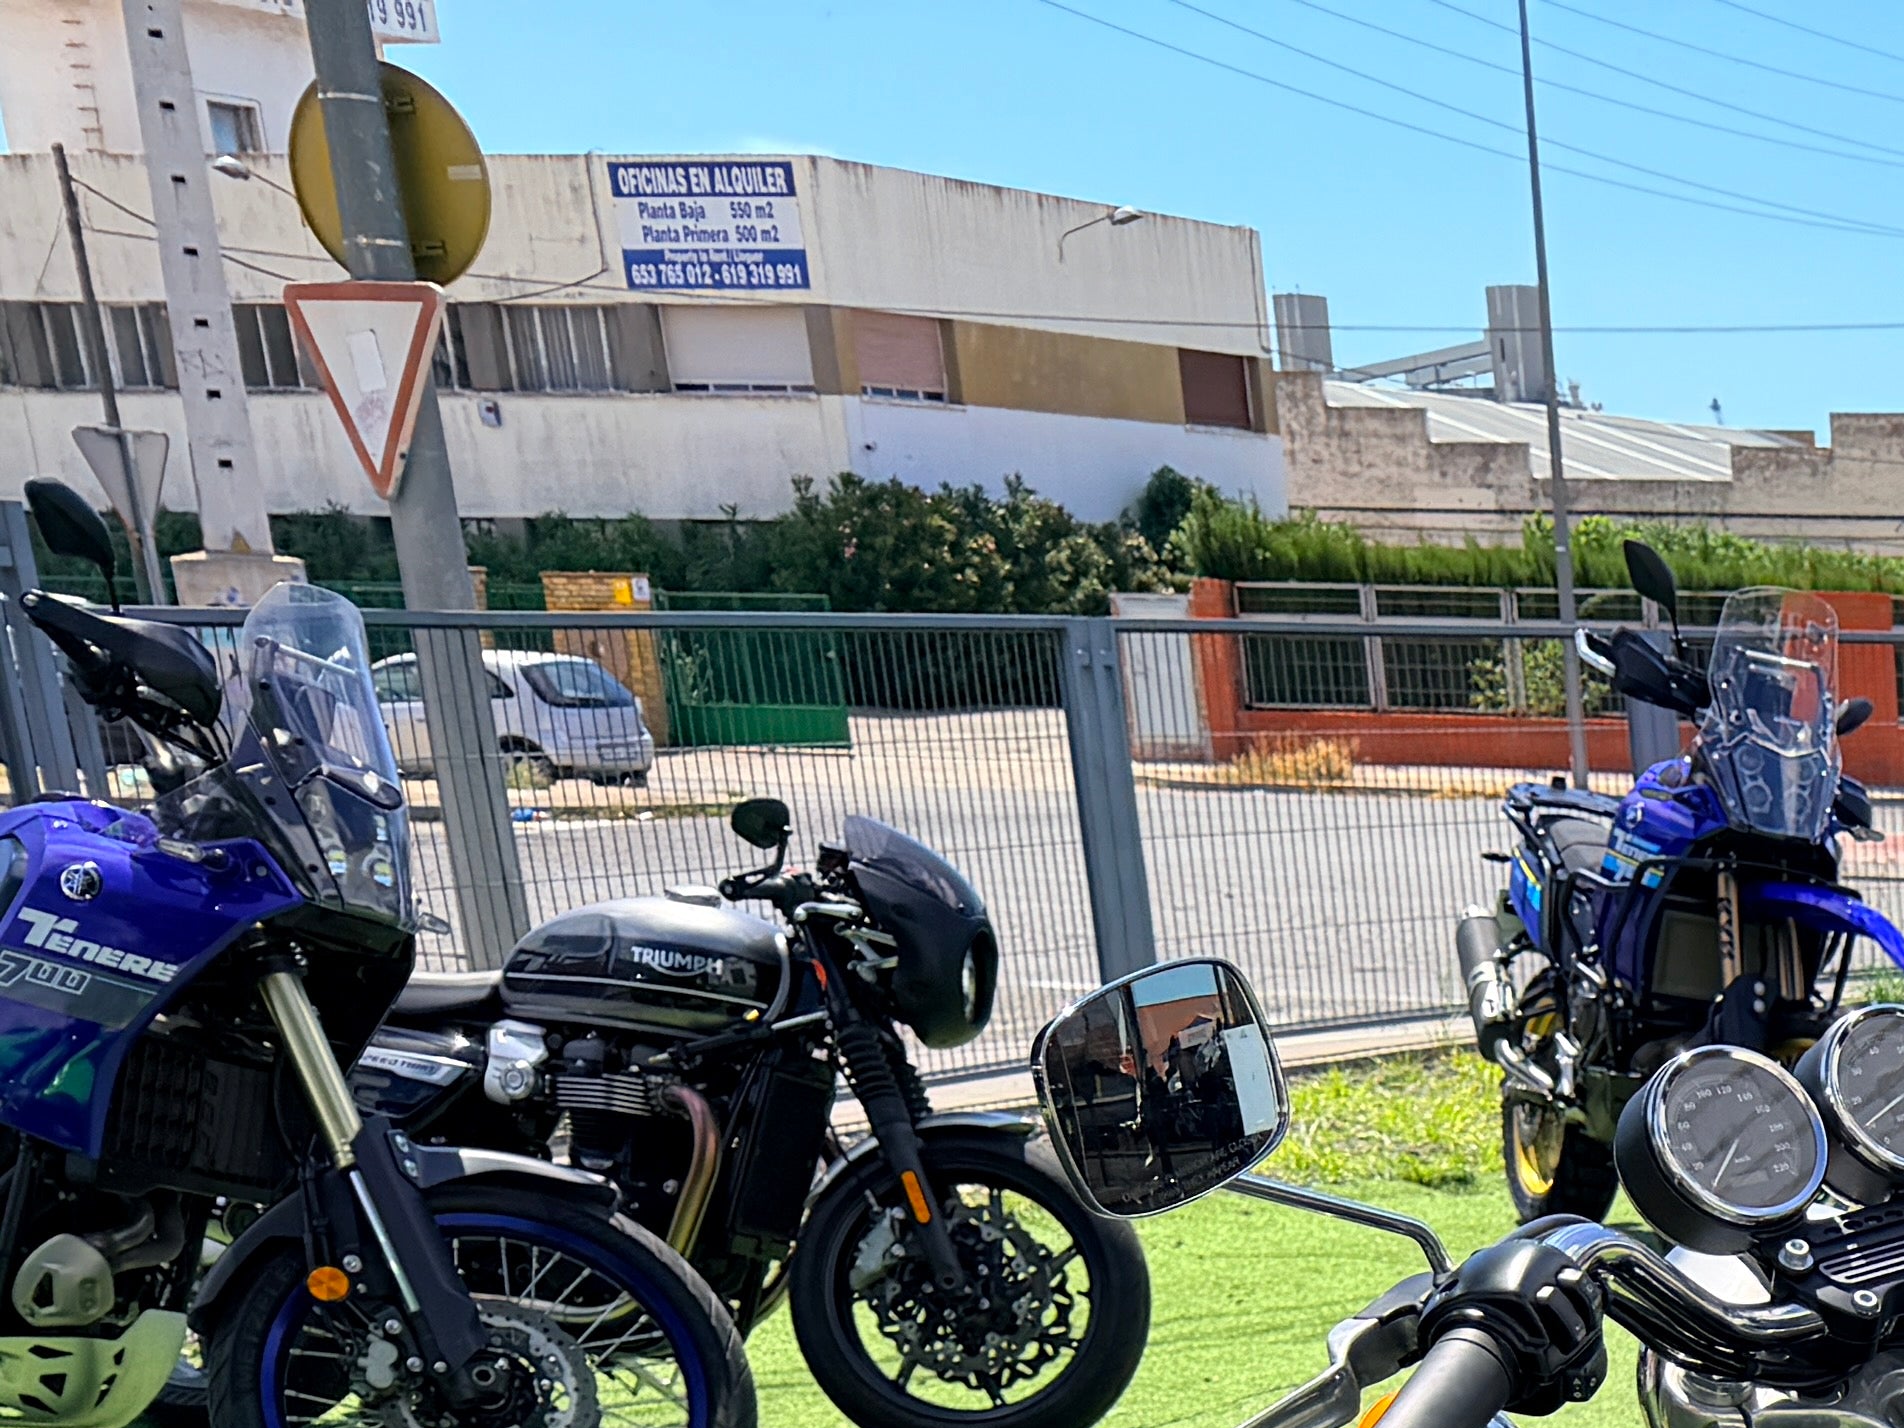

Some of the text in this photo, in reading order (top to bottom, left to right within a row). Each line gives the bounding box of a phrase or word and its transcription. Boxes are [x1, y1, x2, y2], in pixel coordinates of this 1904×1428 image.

[395, 0, 427, 32] 991
[617, 166, 789, 195] OFICINAS EN ALQUILER
[638, 201, 775, 222] Planta Baja 550 m2
[642, 225, 780, 243] Planta Primera 500 m2
[631, 264, 800, 285] 653 765 012 619 319 991
[0, 949, 92, 995] 700
[631, 946, 724, 977] TRIUMPH
